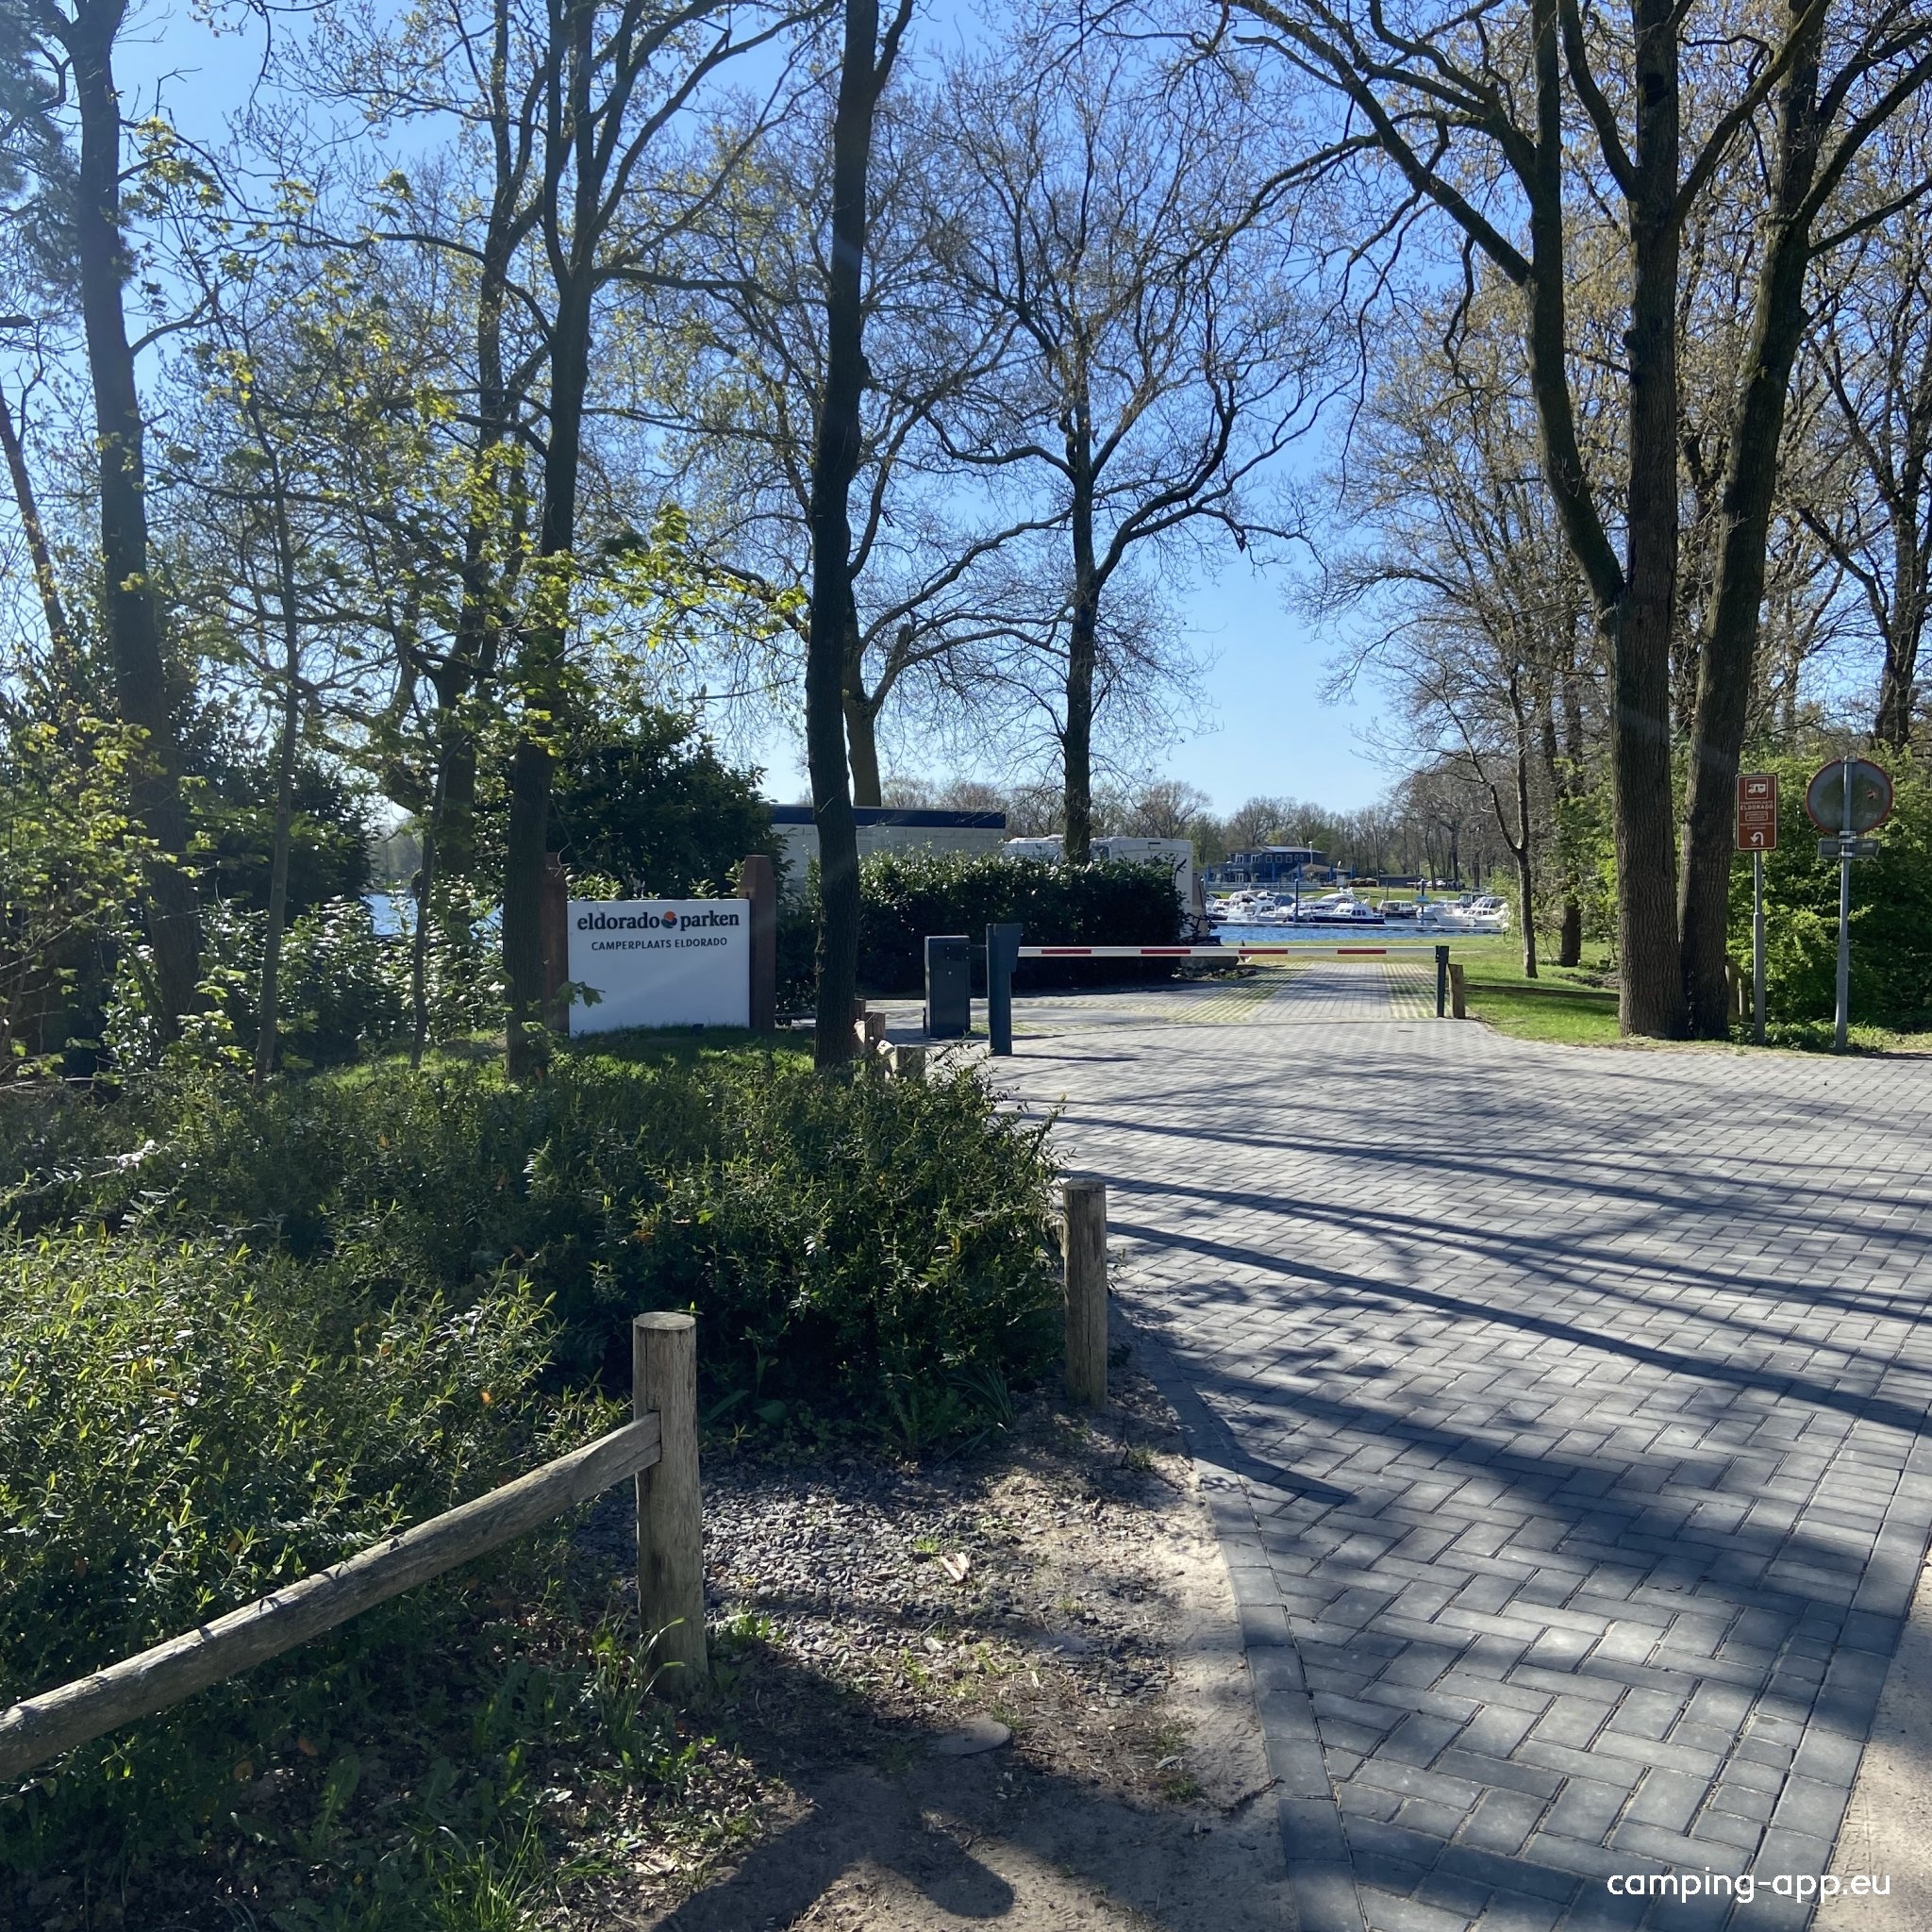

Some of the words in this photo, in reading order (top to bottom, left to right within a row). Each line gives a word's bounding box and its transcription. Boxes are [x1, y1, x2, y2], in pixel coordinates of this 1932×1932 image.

[577, 911, 659, 930] eldorado
[680, 910, 740, 931] parken
[591, 940, 672, 951] CAMPERPLAATS
[675, 937, 727, 948] ELDORADO
